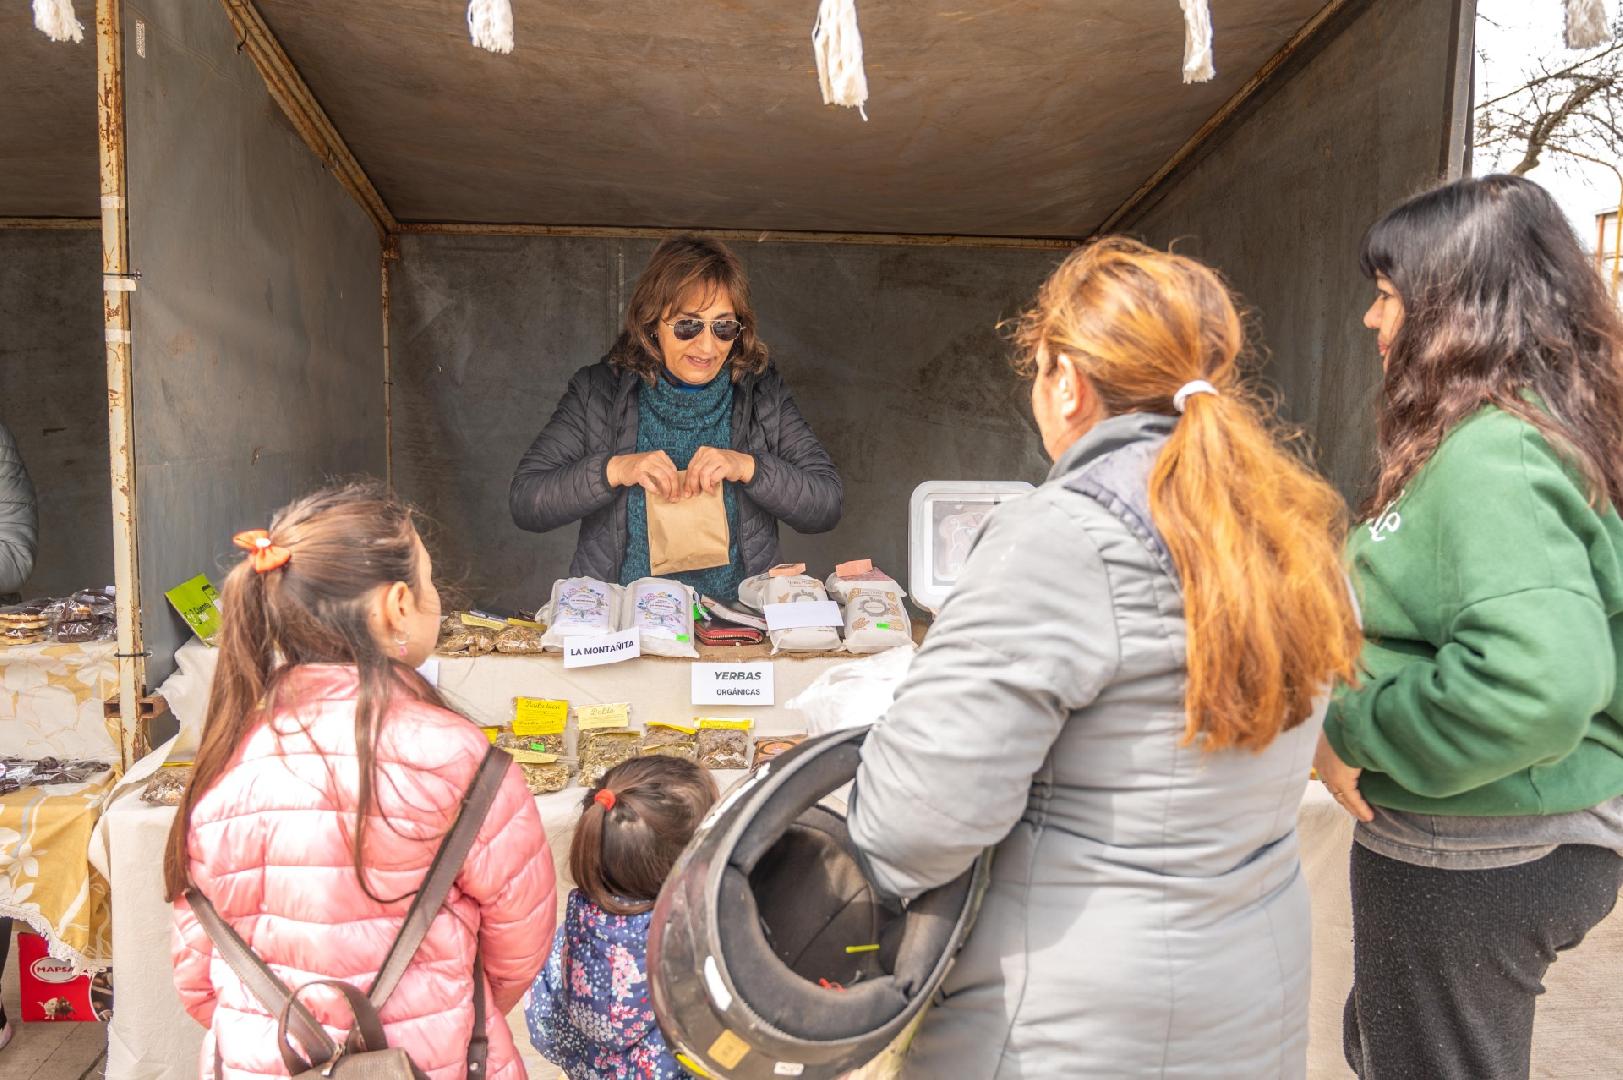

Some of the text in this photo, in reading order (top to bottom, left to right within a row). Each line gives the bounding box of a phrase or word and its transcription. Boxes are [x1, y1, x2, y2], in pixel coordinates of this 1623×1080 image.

[584, 640, 634, 654] MONTAÑITA
[714, 672, 762, 680] YERBAS
[716, 687, 760, 696] ORGÁNICAS
